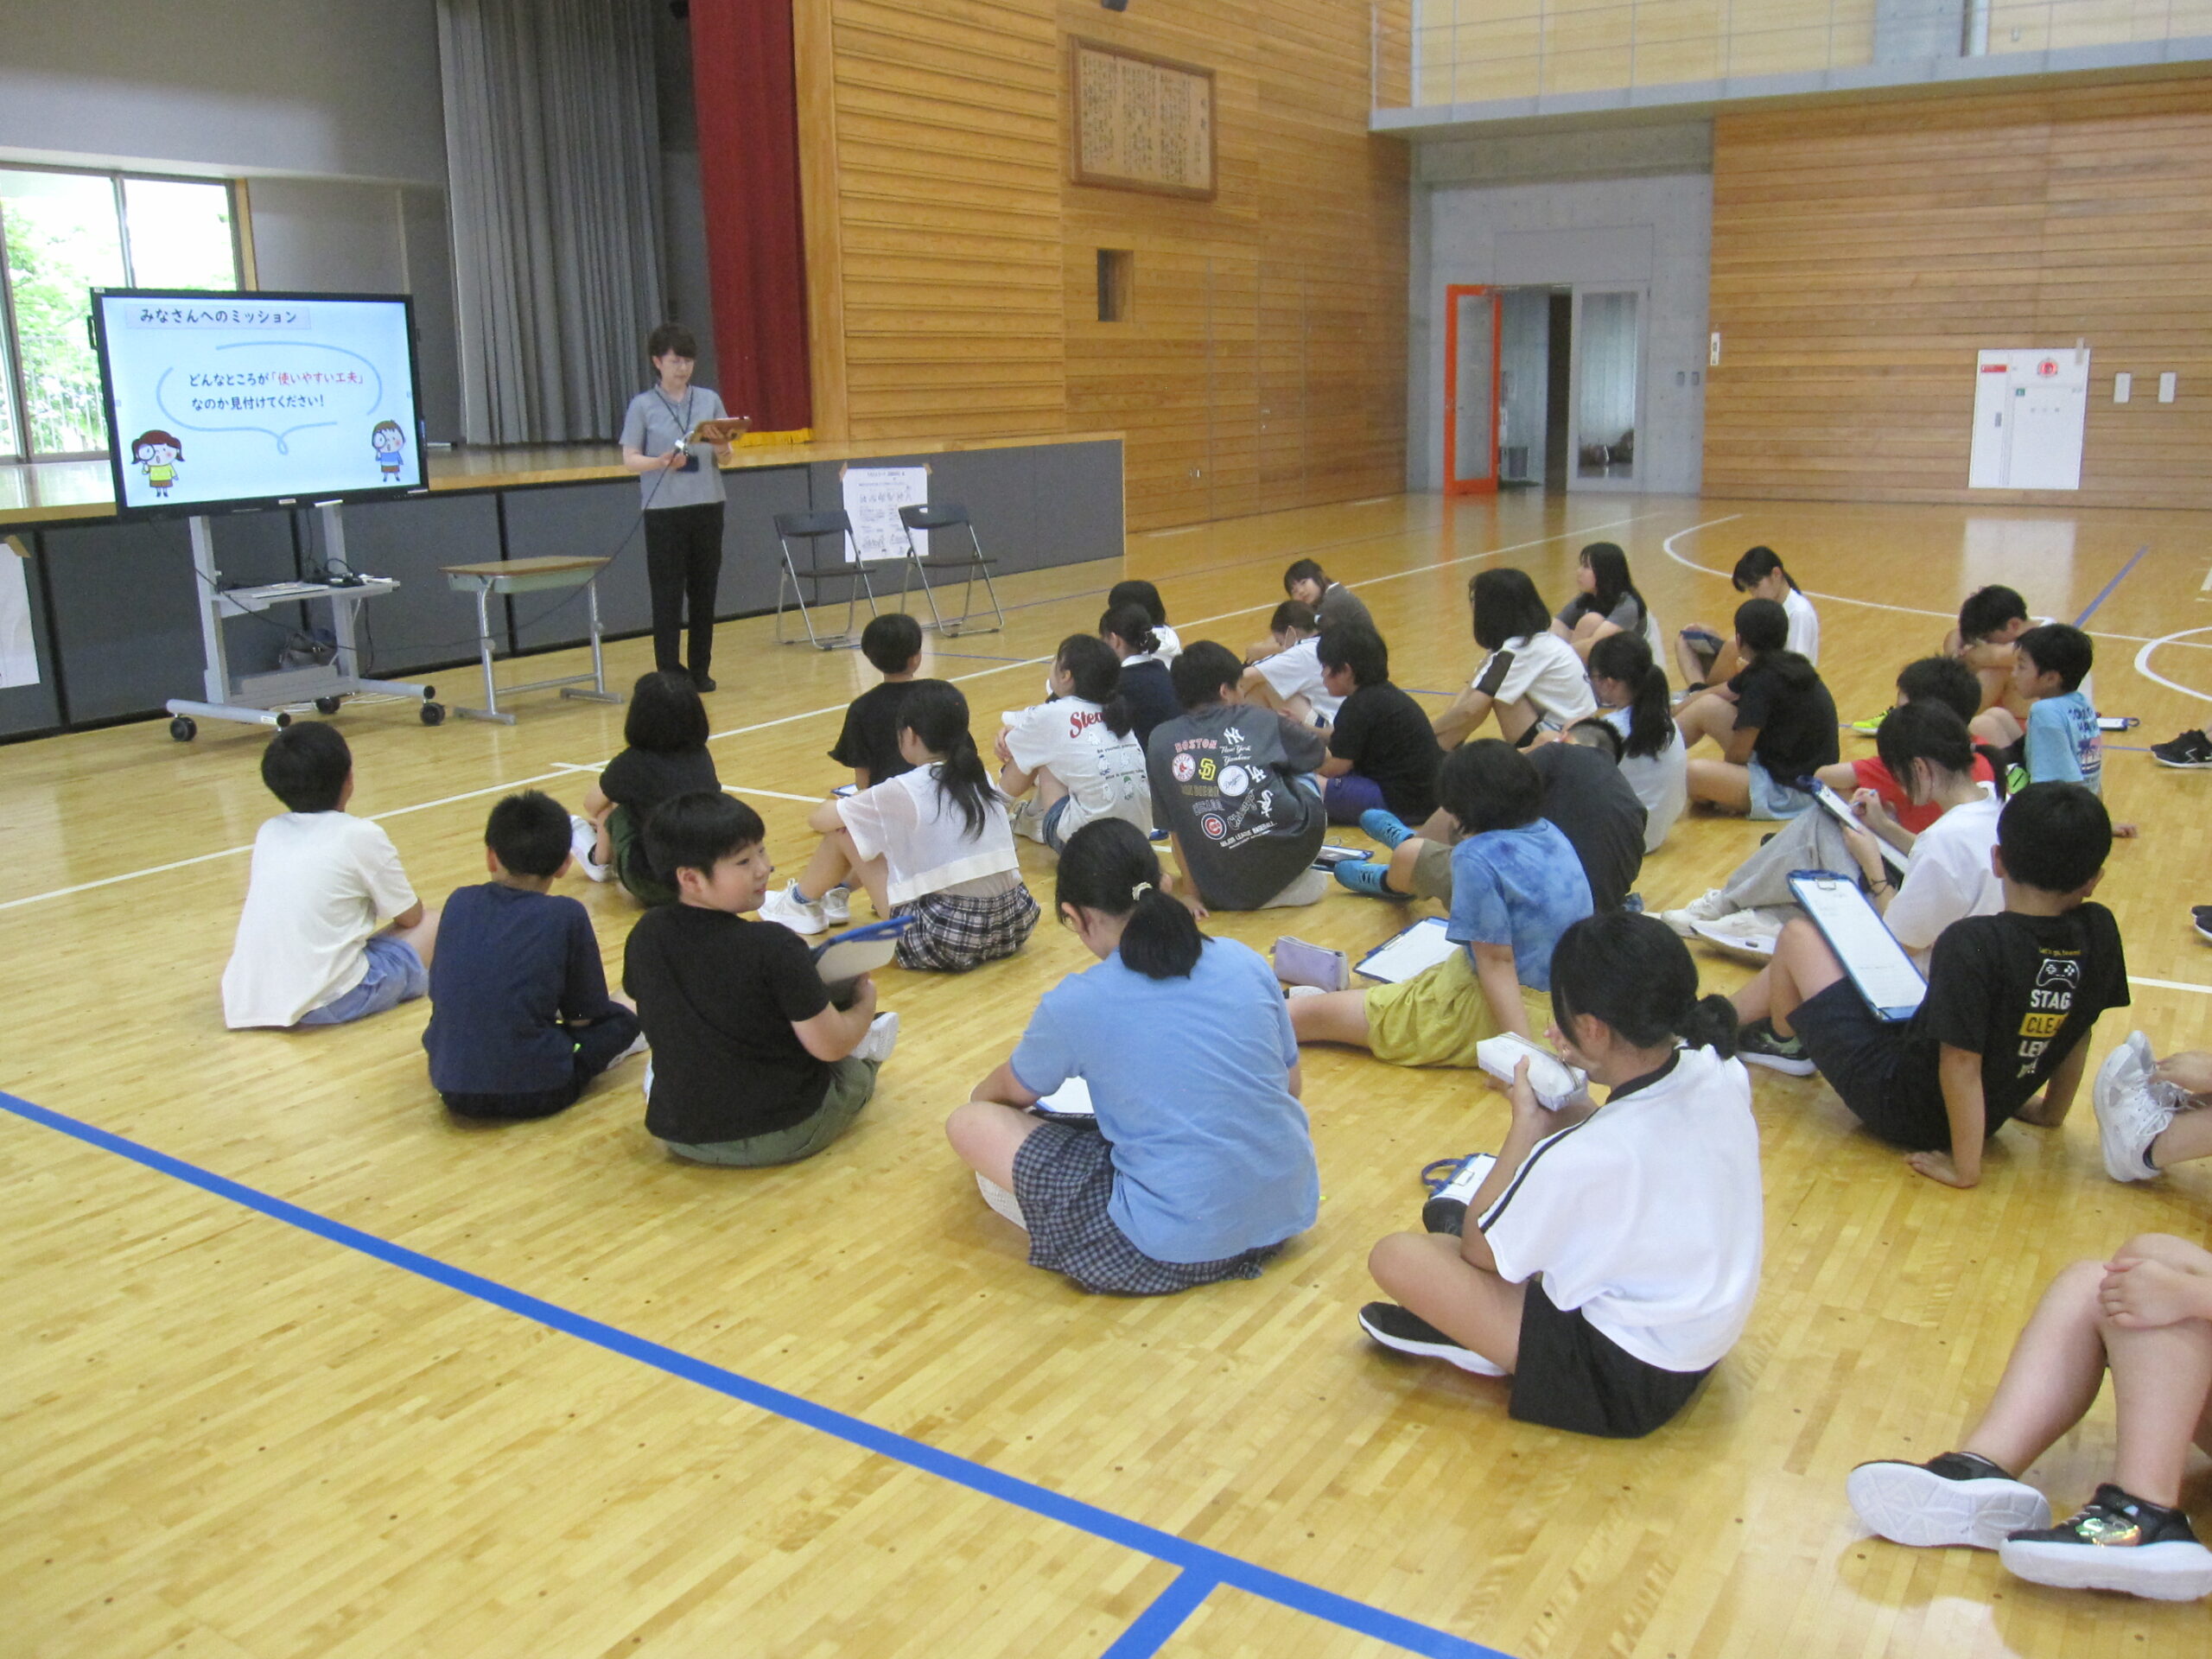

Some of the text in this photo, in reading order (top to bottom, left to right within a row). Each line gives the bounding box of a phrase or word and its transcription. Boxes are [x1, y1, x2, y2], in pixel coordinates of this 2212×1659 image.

[140, 308, 296, 324] みなさんへのミッション
[189, 372, 364, 387] どんなところが「使いやすい工夫」
[1174, 738, 1218, 753] BOSTON
[1198, 758, 1217, 781] SD
[1245, 764, 1267, 783] LA
[2031, 988, 2072, 1010] STAG
